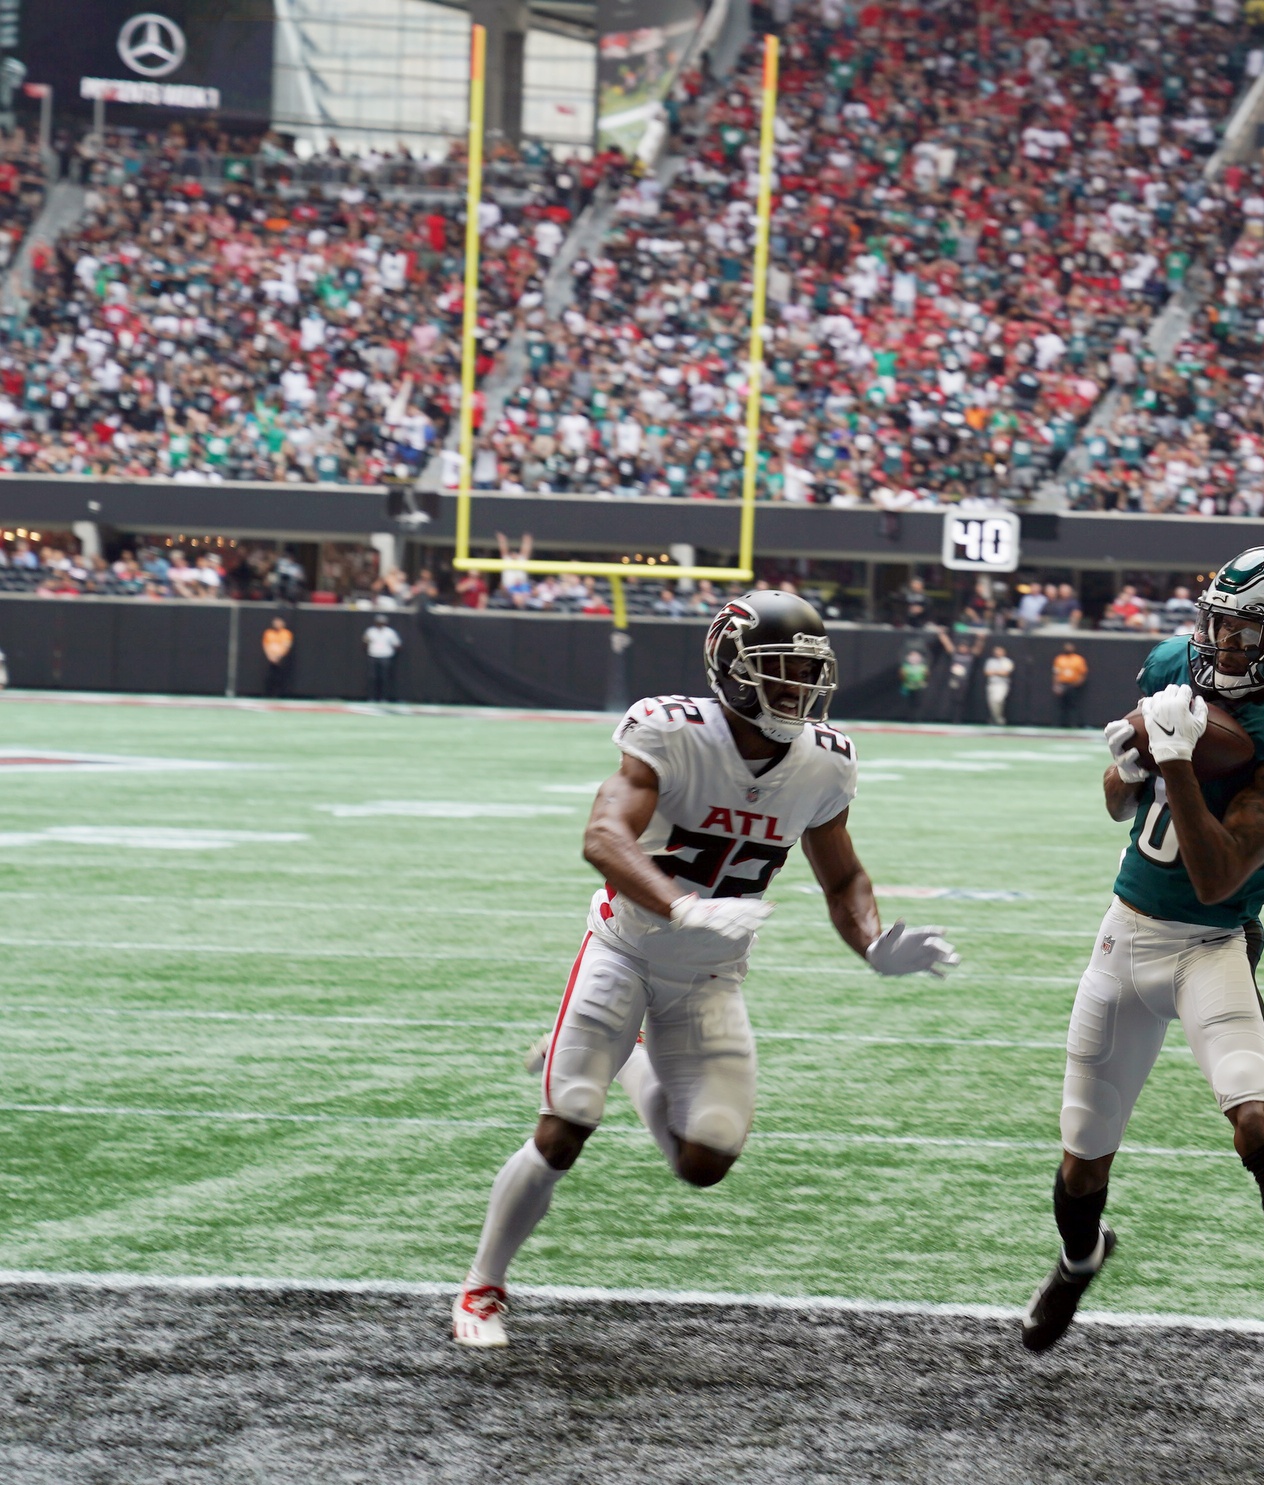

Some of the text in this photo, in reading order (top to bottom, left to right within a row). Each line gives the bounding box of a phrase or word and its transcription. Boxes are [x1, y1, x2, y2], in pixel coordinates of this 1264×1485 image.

[951, 519, 1012, 564] 40
[698, 805, 783, 841] ATL
[650, 824, 794, 899] 22
